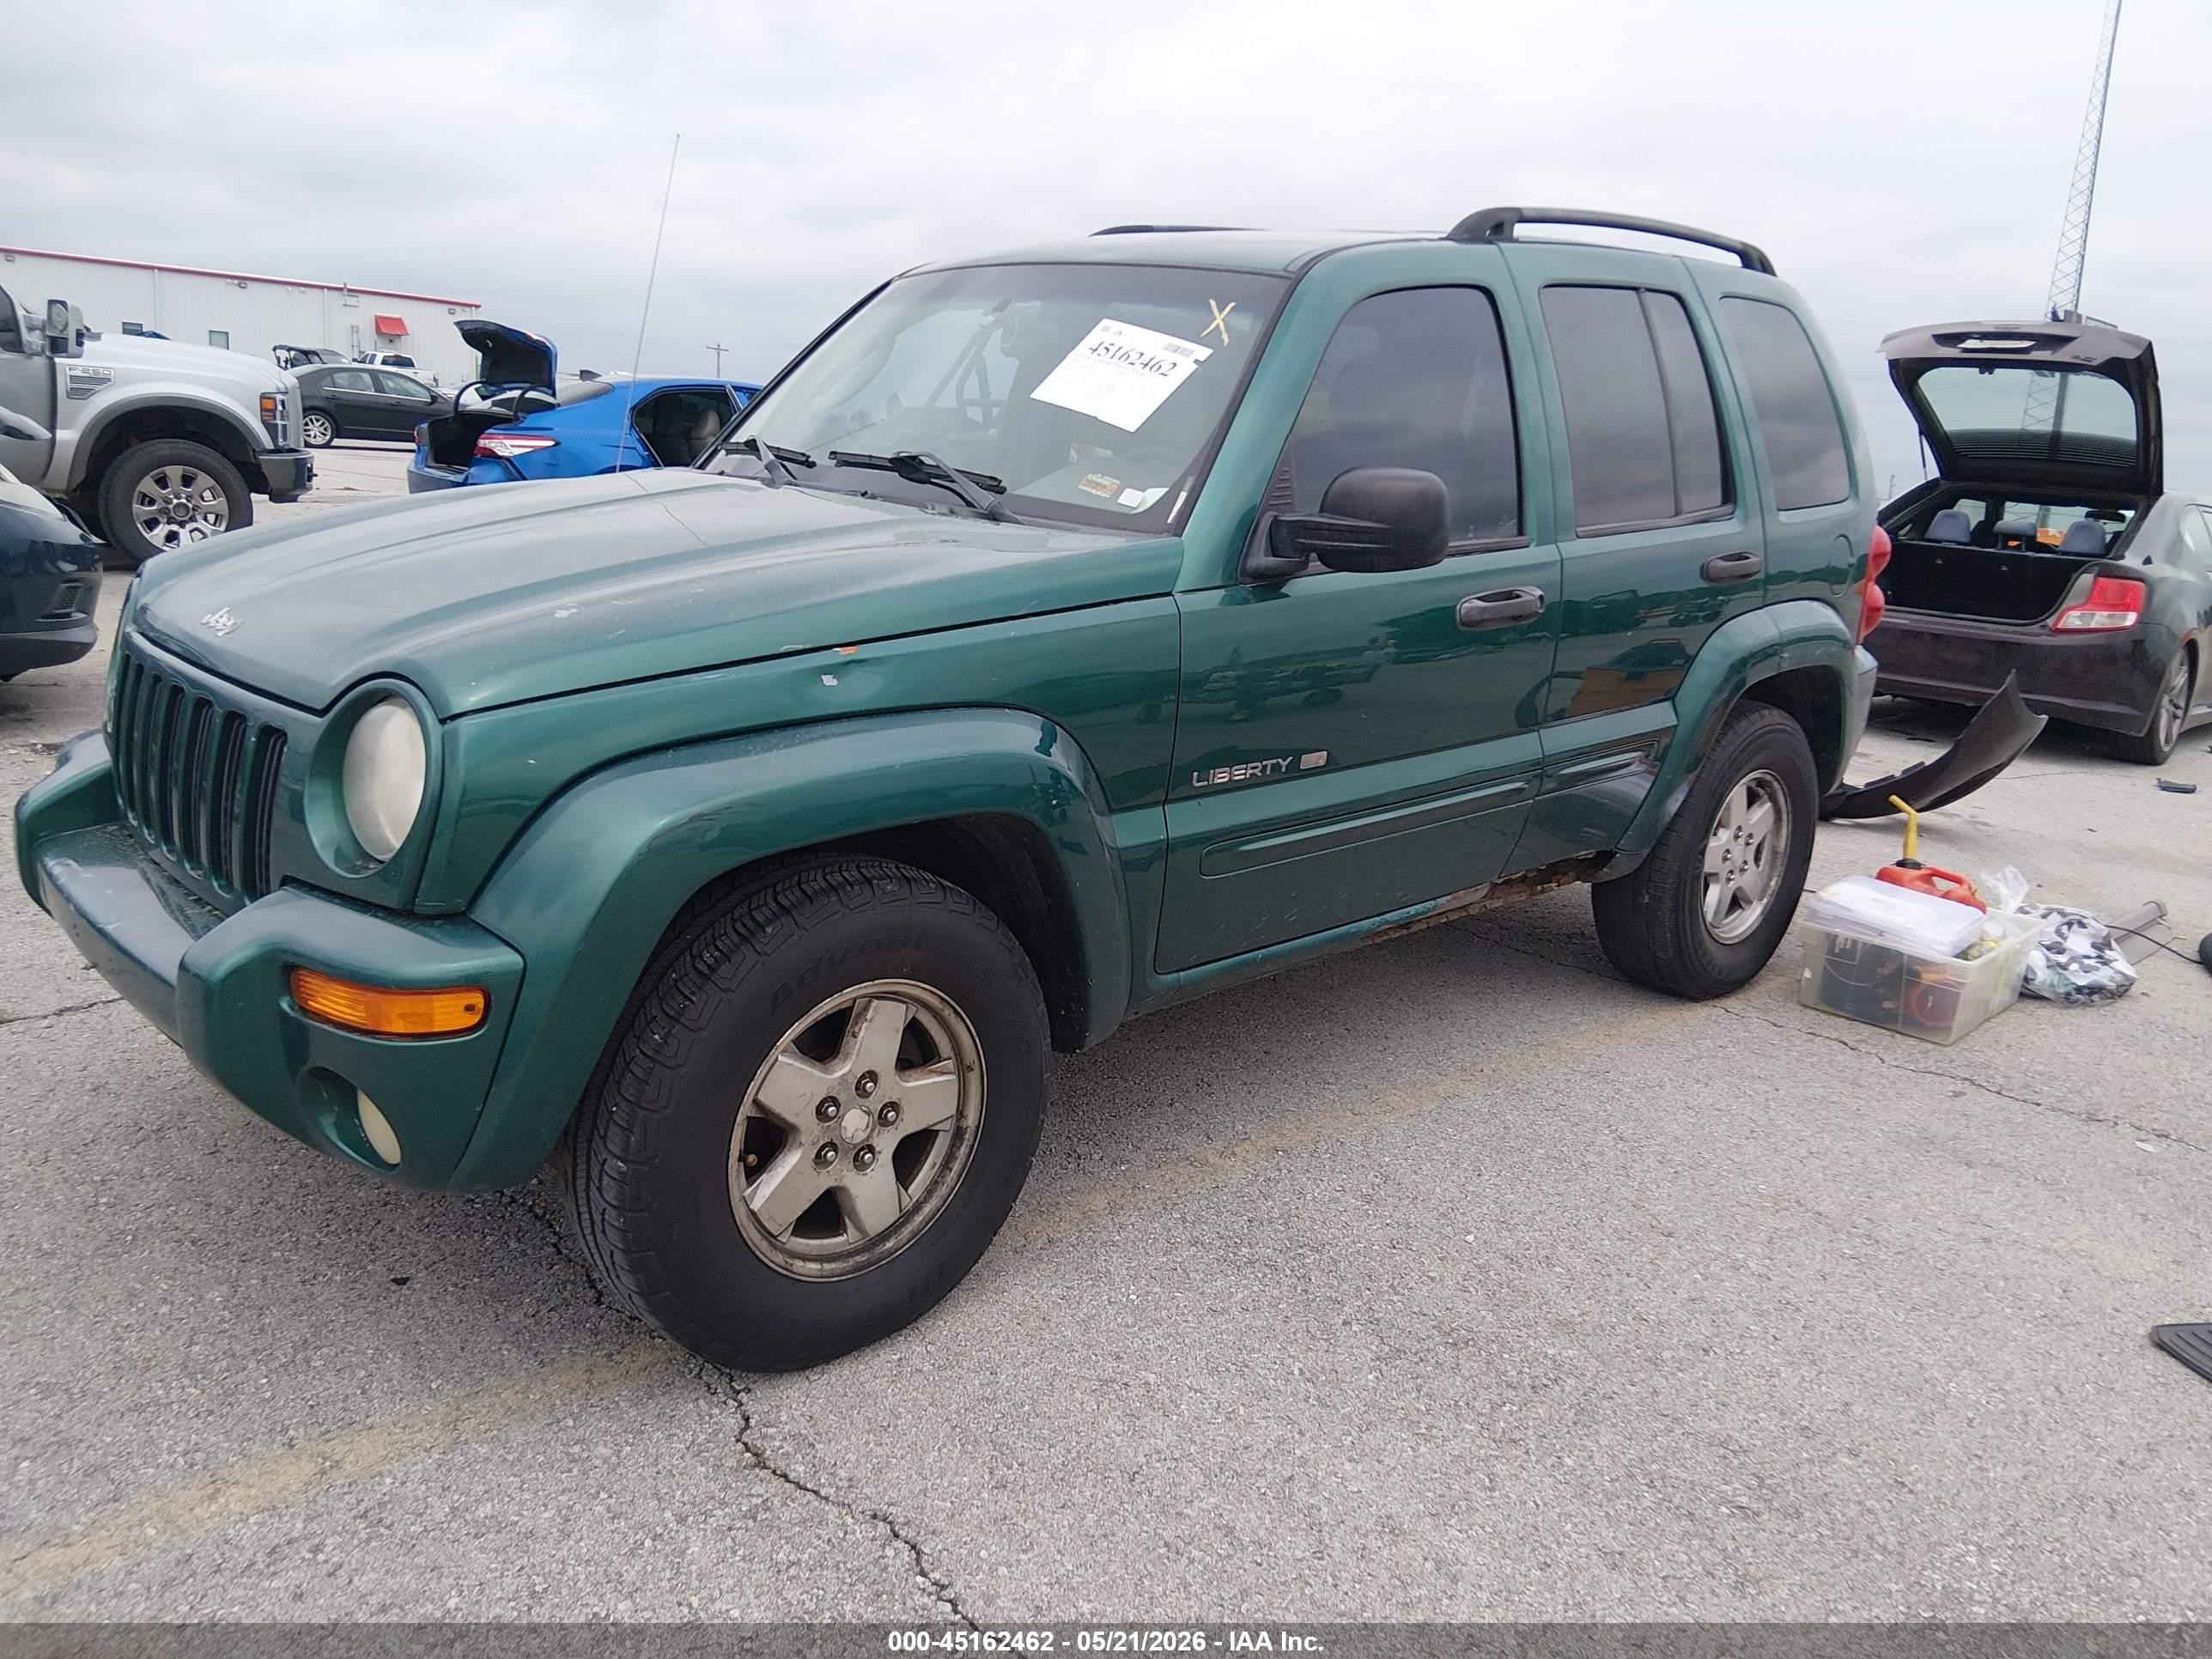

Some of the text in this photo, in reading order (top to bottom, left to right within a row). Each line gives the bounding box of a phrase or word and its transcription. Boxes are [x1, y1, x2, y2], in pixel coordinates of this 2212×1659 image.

[1200, 298, 1237, 348] X
[69, 367, 112, 376] F-250
[1089, 340, 1177, 378] 45162462
[1192, 756, 1294, 787] LIBERTY
